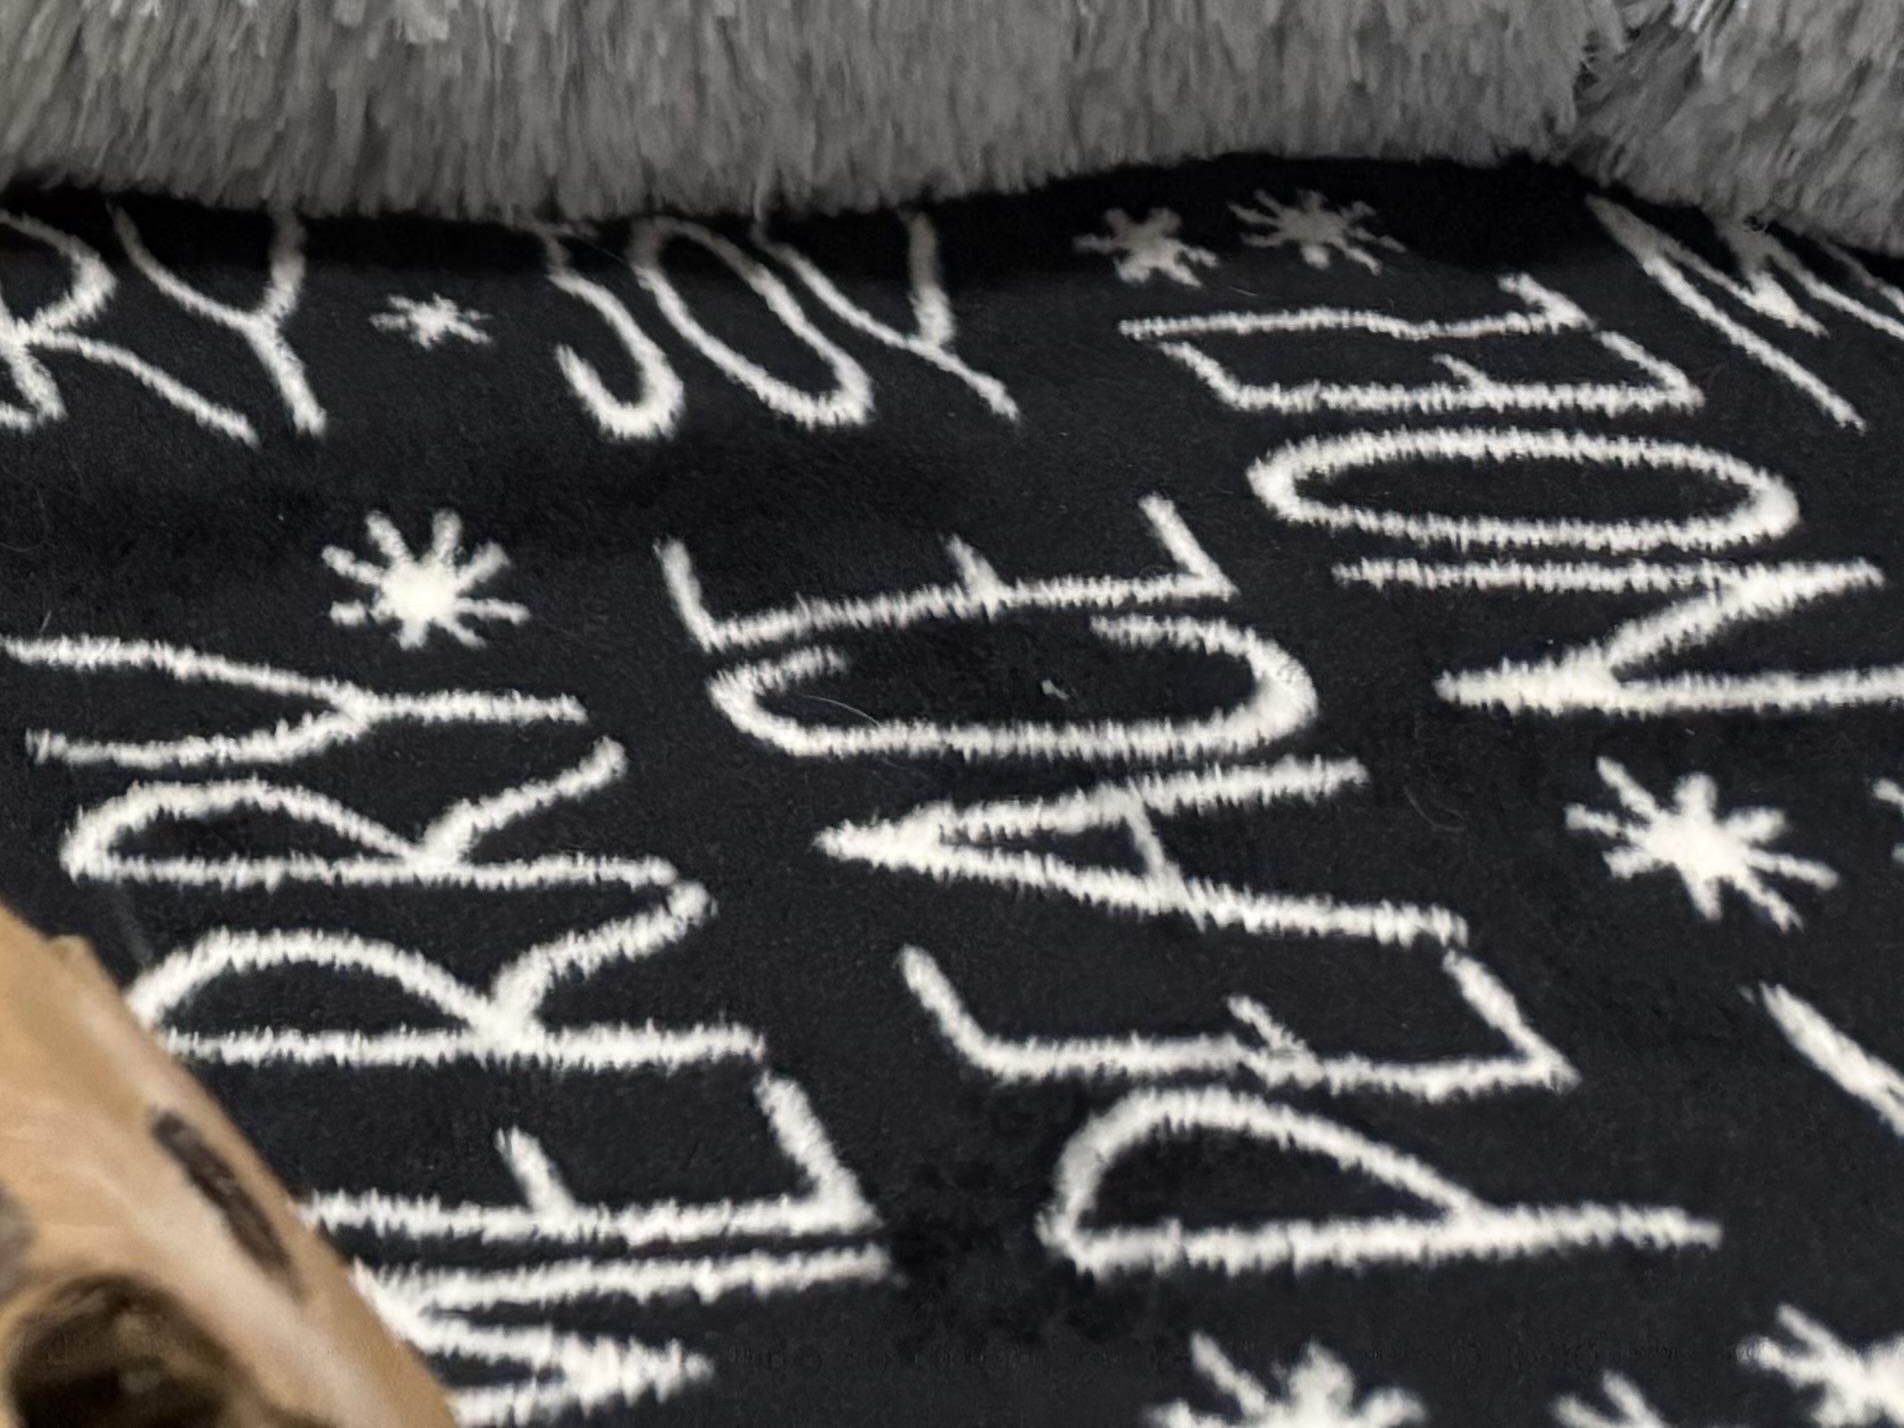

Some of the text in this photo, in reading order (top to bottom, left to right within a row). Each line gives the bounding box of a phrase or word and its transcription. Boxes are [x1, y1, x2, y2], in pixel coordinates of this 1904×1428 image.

[502, 206, 1020, 442] JOY
[1118, 268, 1904, 718] NOEL
[656, 494, 1724, 1276] PEACE
